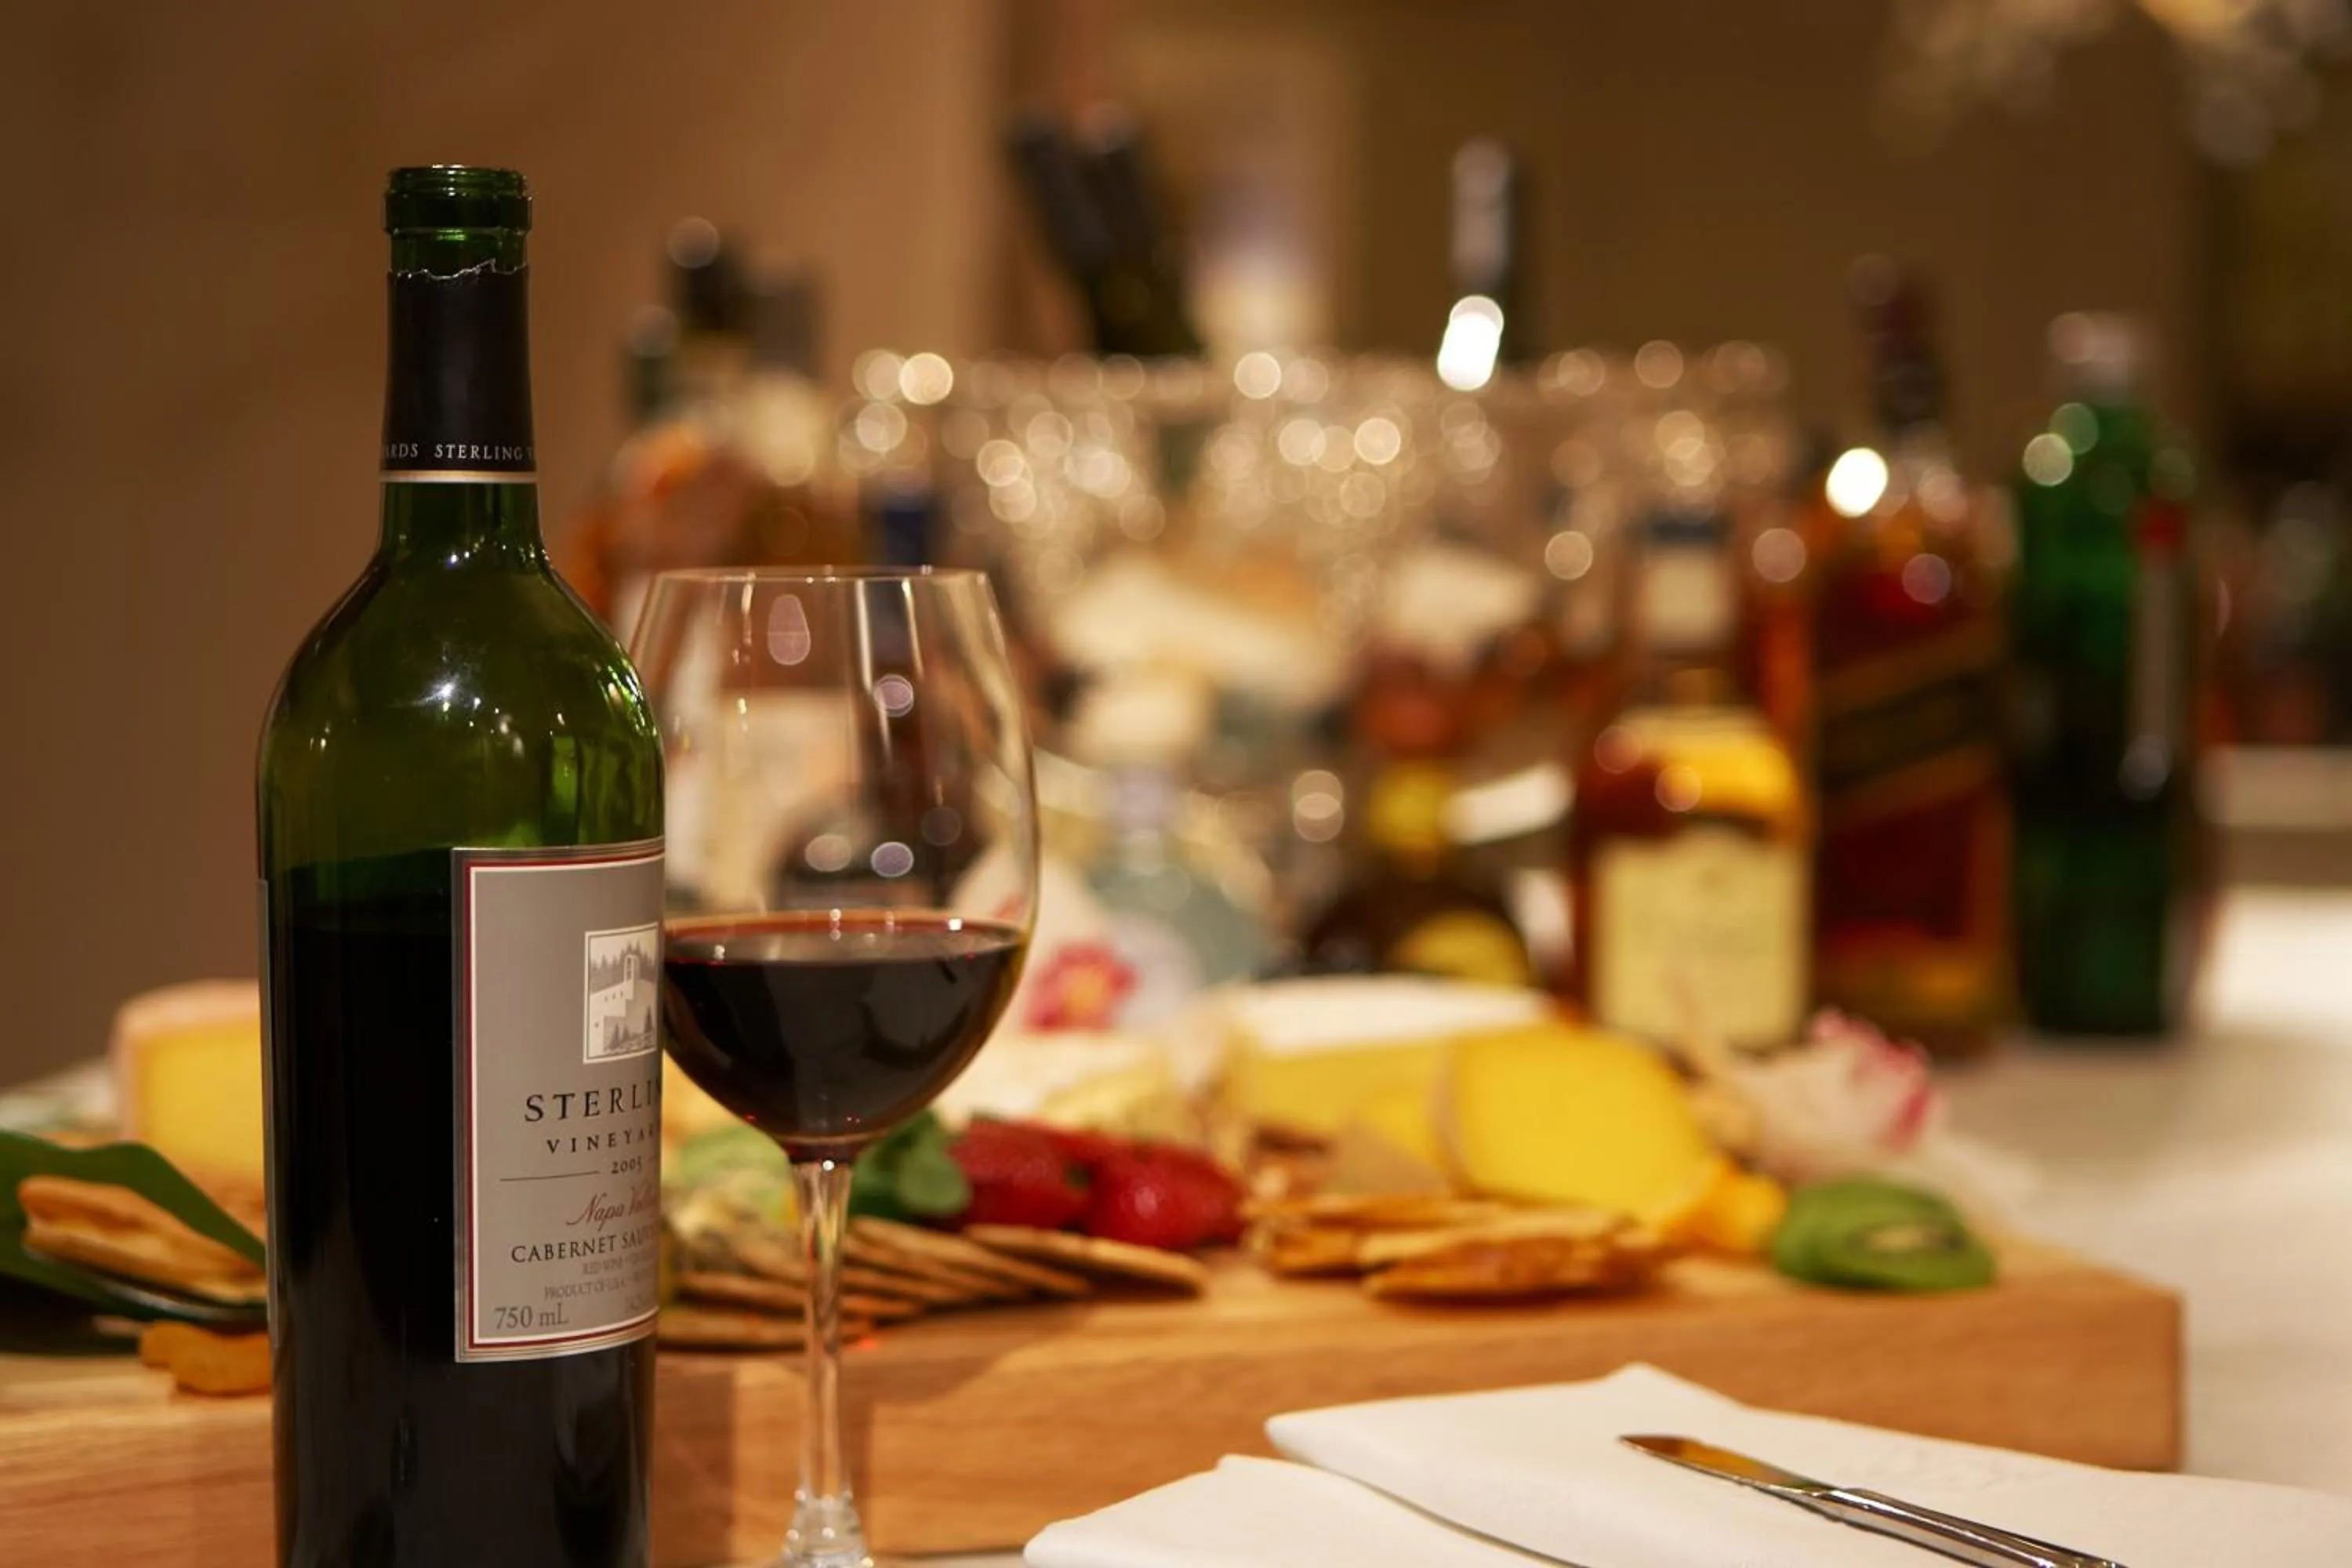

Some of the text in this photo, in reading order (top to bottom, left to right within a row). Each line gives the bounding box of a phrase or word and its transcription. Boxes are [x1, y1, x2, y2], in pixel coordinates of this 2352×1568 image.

[386, 442, 419, 460] RDS
[434, 443, 523, 460] STERLING
[564, 1192, 626, 1232] Napa
[511, 1234, 615, 1263] CABERNET
[495, 1302, 569, 1329] 750 mL
